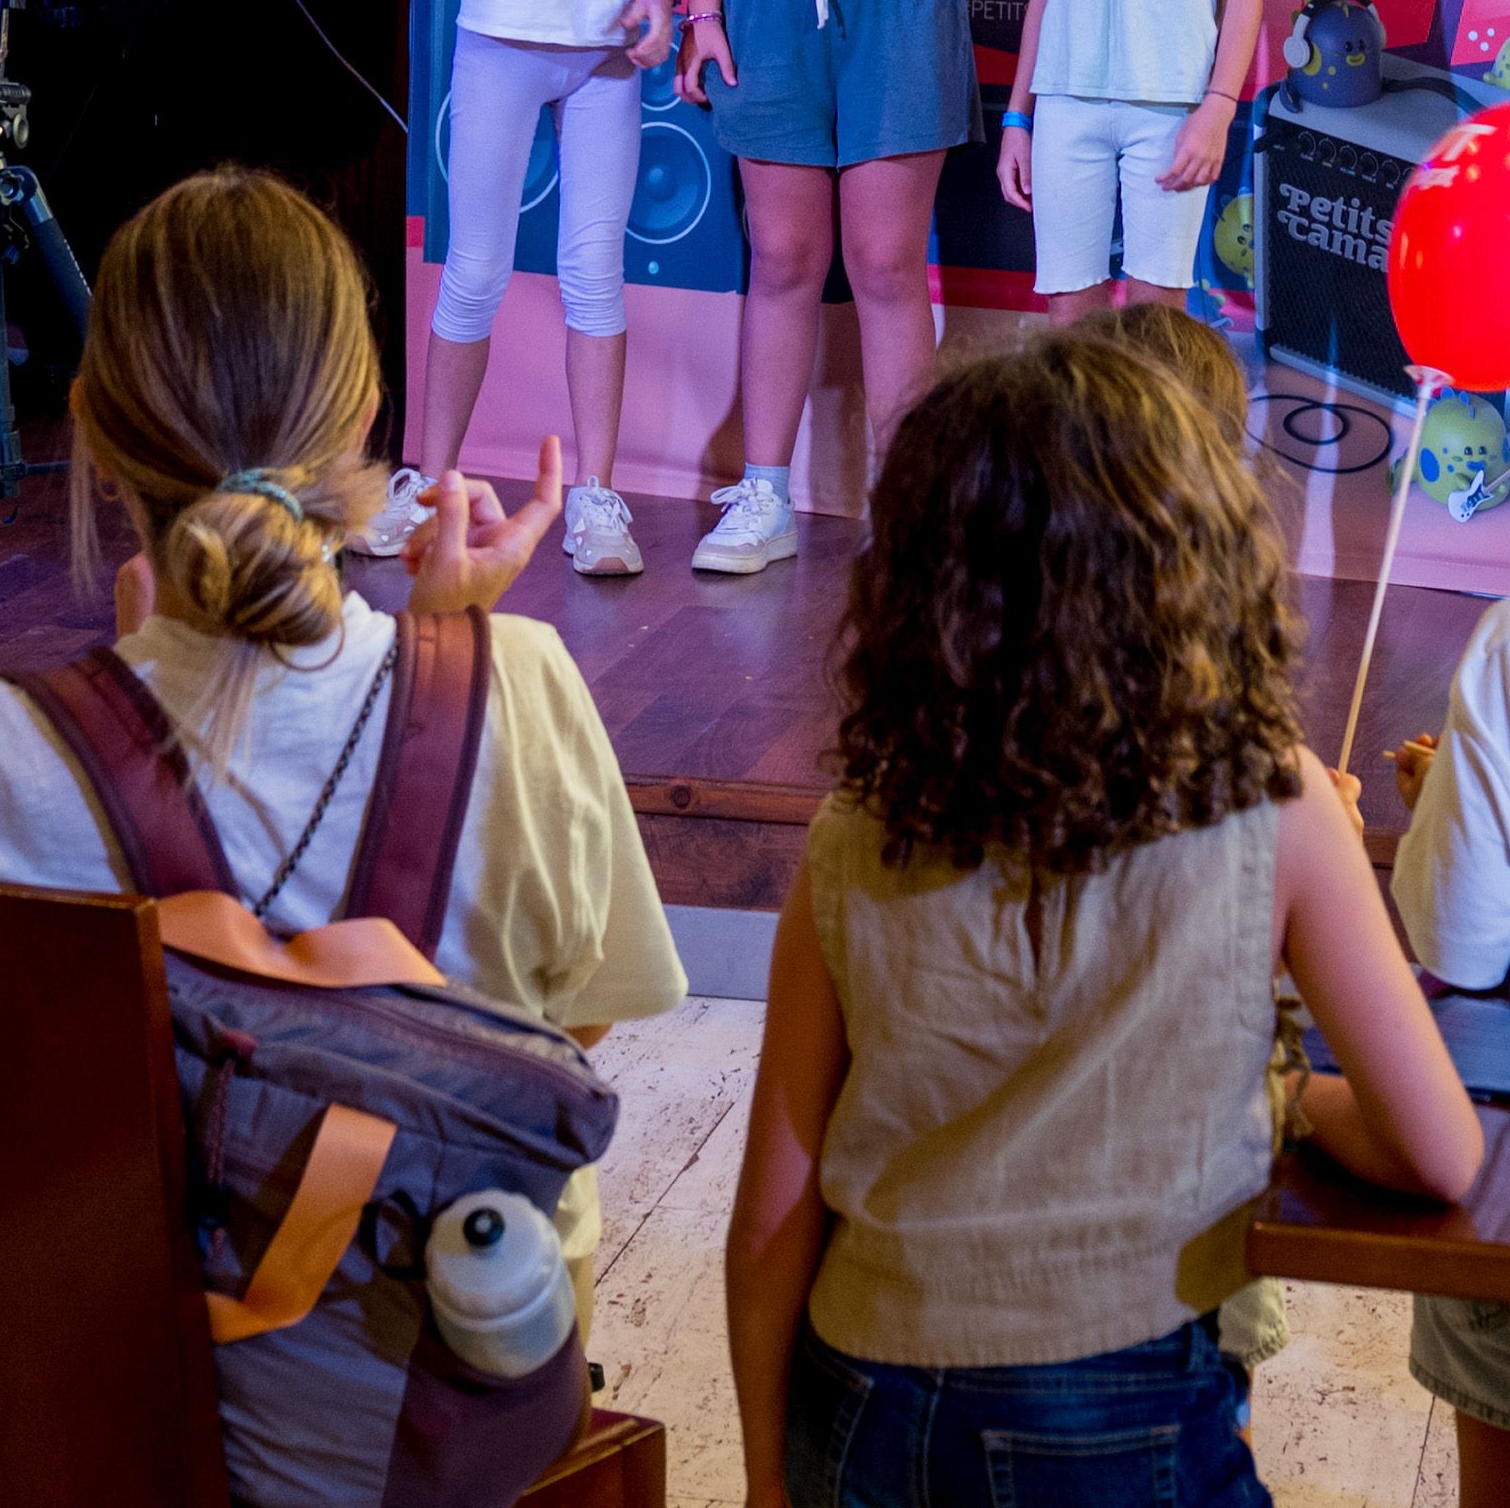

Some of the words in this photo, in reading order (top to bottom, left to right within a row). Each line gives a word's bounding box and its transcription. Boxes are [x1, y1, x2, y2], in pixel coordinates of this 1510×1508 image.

[968, 0, 1029, 21] PETIT
[1277, 210, 1390, 273] Cama
[1279, 183, 1395, 246] Petits
